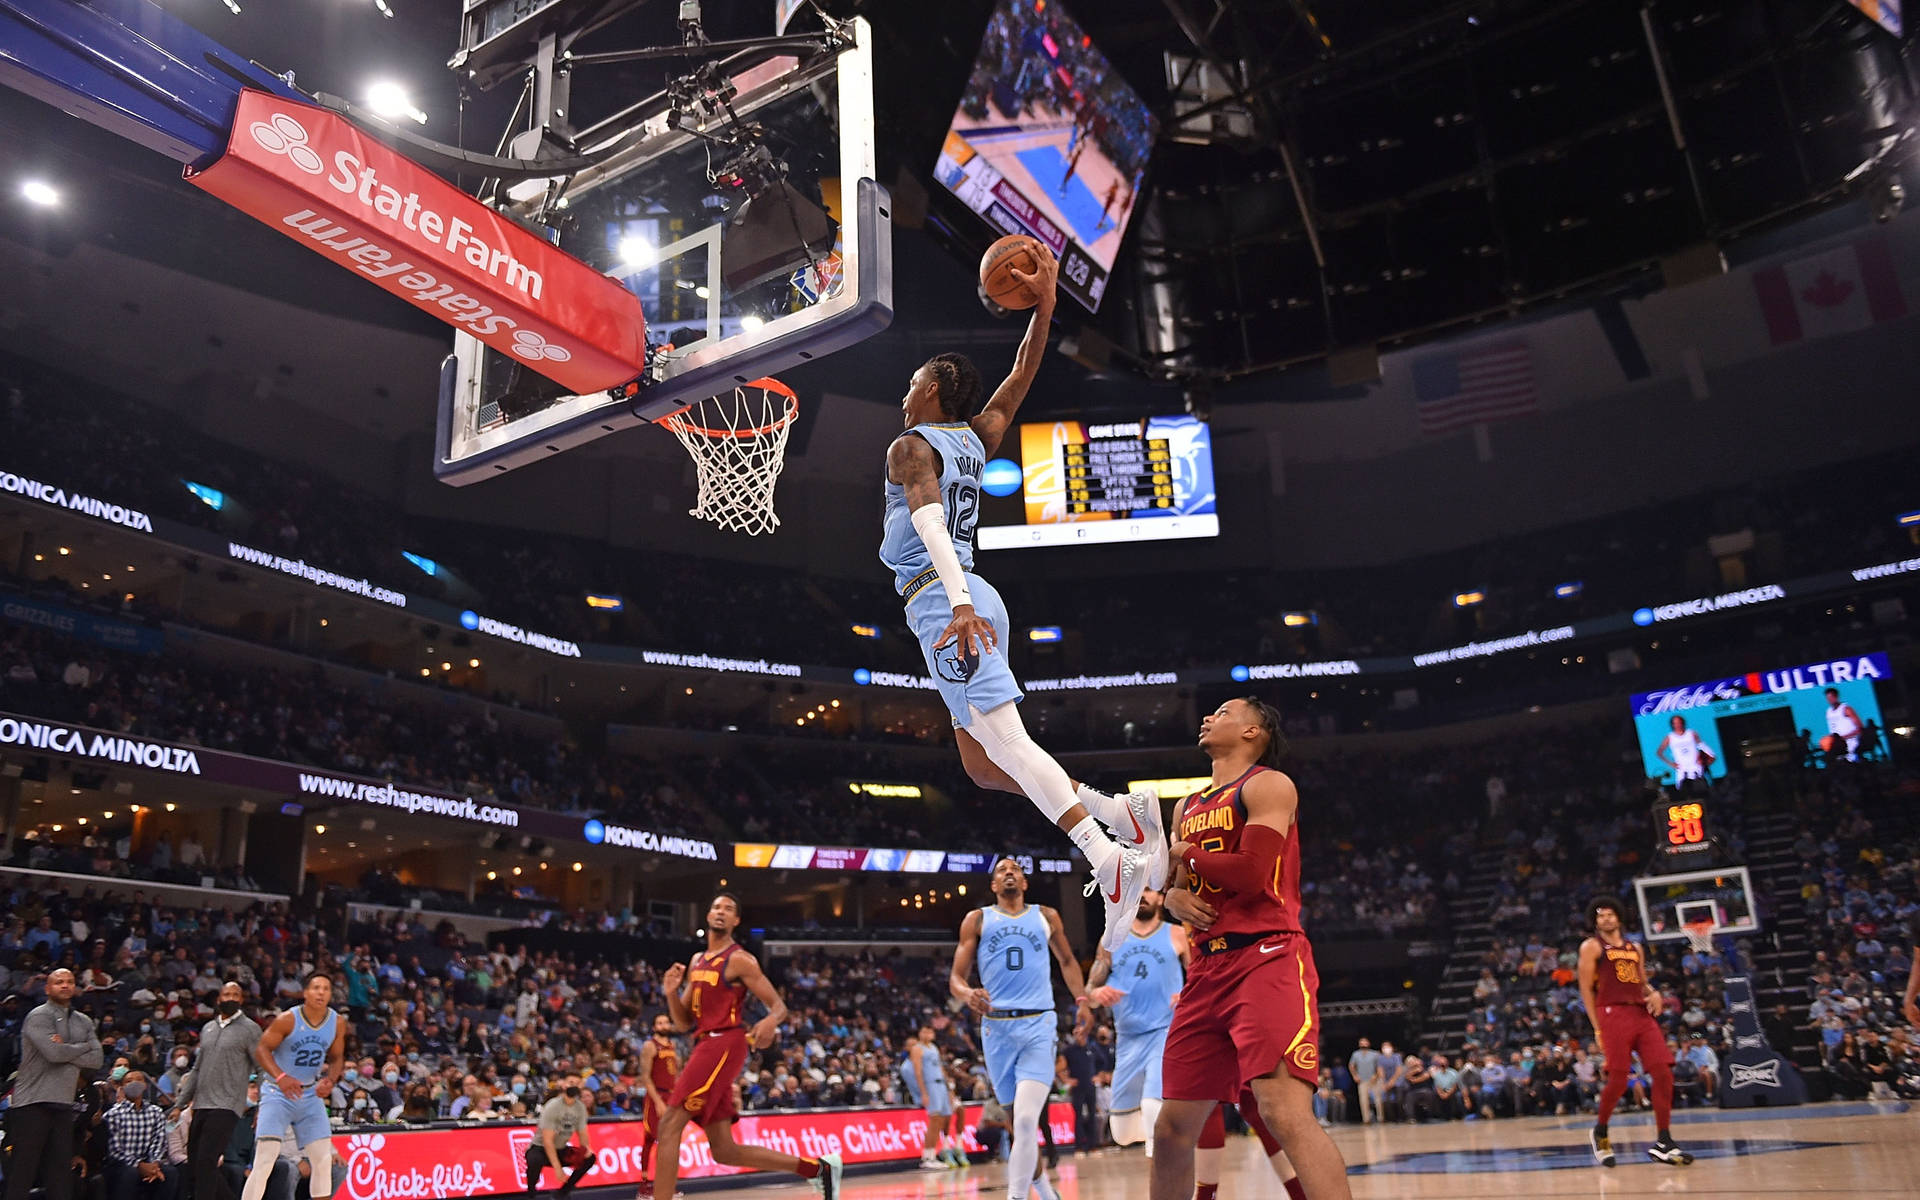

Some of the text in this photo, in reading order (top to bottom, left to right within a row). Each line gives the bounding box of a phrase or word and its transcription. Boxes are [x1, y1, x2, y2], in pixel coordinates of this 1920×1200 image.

[69, 493, 154, 533] MINOLTA
[947, 482, 977, 543] 12
[229, 541, 407, 608] www.reshapework.com
[1653, 584, 1787, 623] KONICA MINOLTA
[478, 616, 582, 659] KONICA MINOLTA
[1413, 626, 1575, 668] www.reshapework.com
[642, 651, 801, 678] www.reshapework.com
[870, 671, 919, 689] KONICA
[1024, 670, 1178, 692] www.reshapework.com
[1250, 660, 1360, 680] KONICA MINOLTA
[1766, 656, 1882, 695] ULTRA
[0, 718, 201, 776] ONICA MINOLTA
[299, 773, 519, 827] www.reshapework.com
[604, 824, 718, 862] KONICA MINOLTA
[1668, 820, 1704, 845] 20
[988, 925, 1042, 954] GRIZZLIES
[1118, 945, 1165, 967] GRIZZLIES
[1006, 946, 1024, 971] 0
[1133, 960, 1149, 980] 4
[294, 1050, 323, 1067] 22
[801, 1126, 842, 1158] the
[346, 1147, 495, 1200] Chick-fil-A
